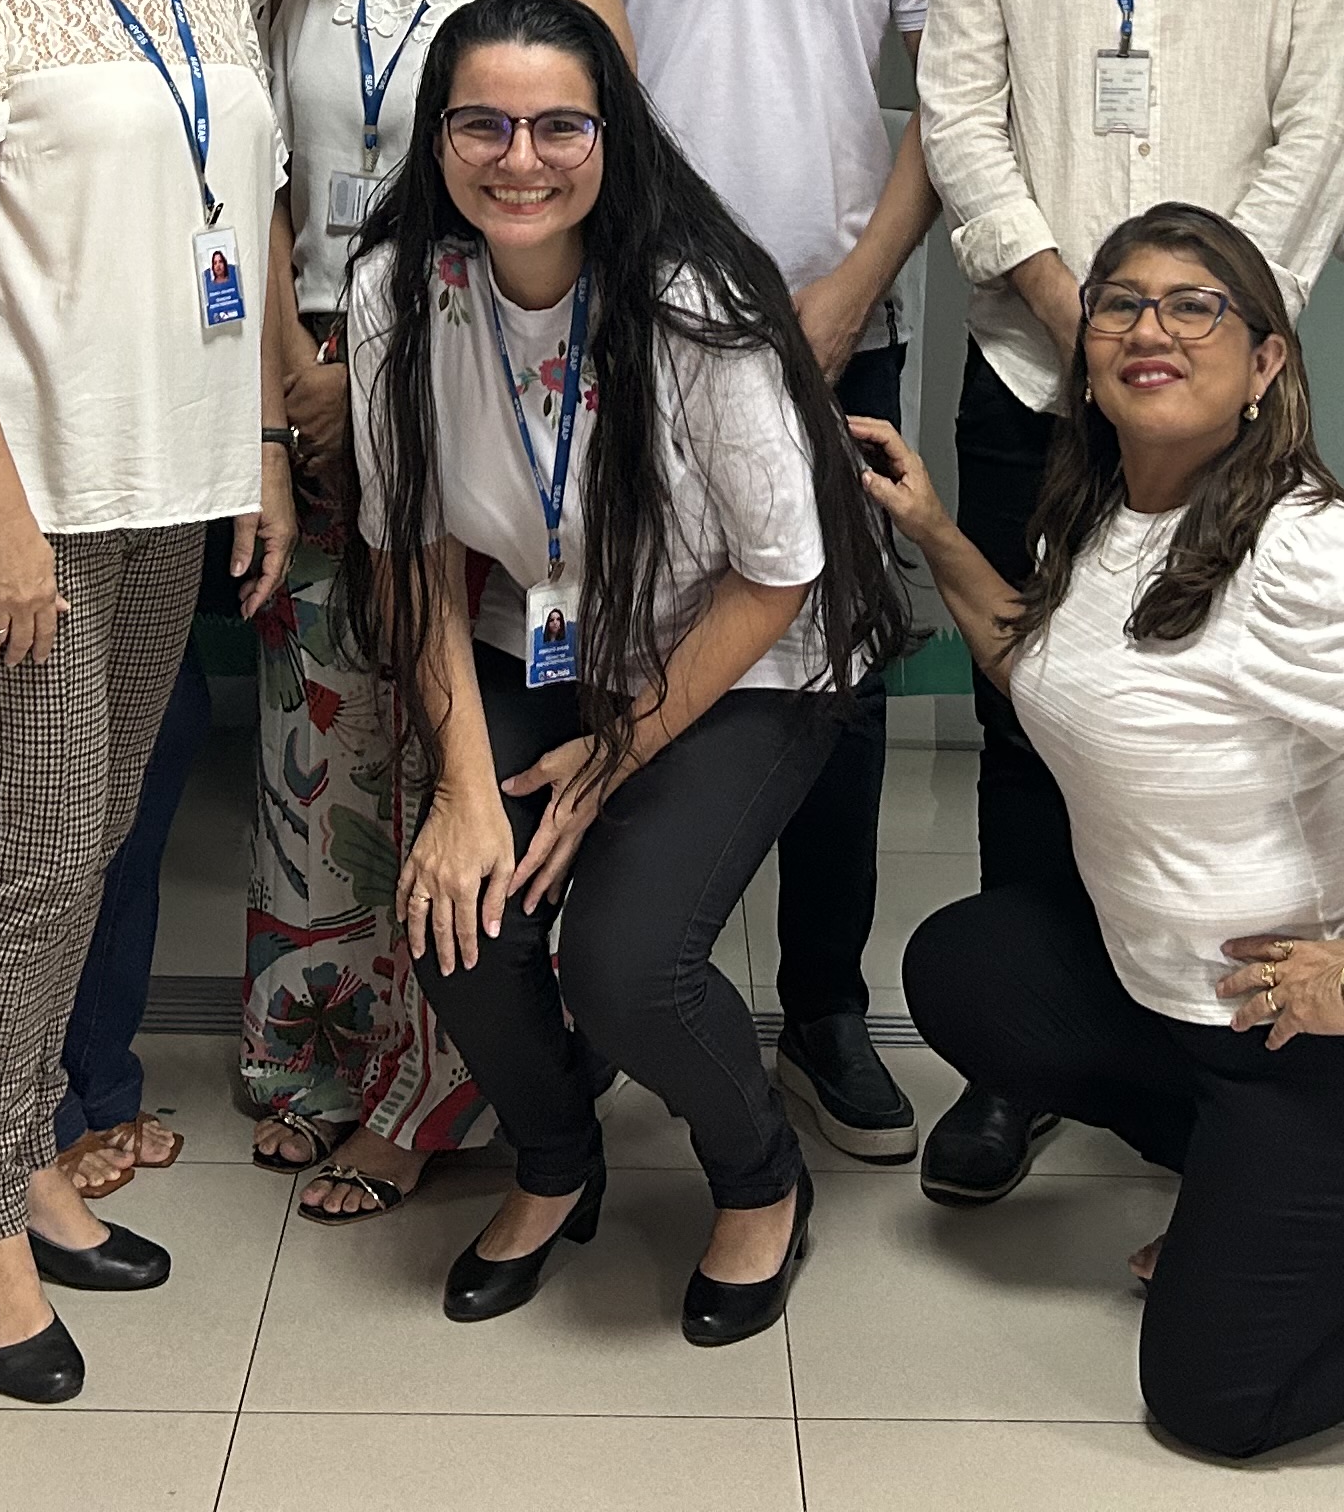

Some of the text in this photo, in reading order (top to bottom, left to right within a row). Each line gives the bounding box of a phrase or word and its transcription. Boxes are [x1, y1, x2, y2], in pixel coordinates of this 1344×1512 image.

[128, 23, 149, 45] SEAP
[365, 73, 373, 97] SEAP
[197, 118, 206, 143] SEAP
[570, 345, 580, 371] SEAP
[562, 414, 571, 441] SEAP
[553, 484, 562, 511] SEAP
